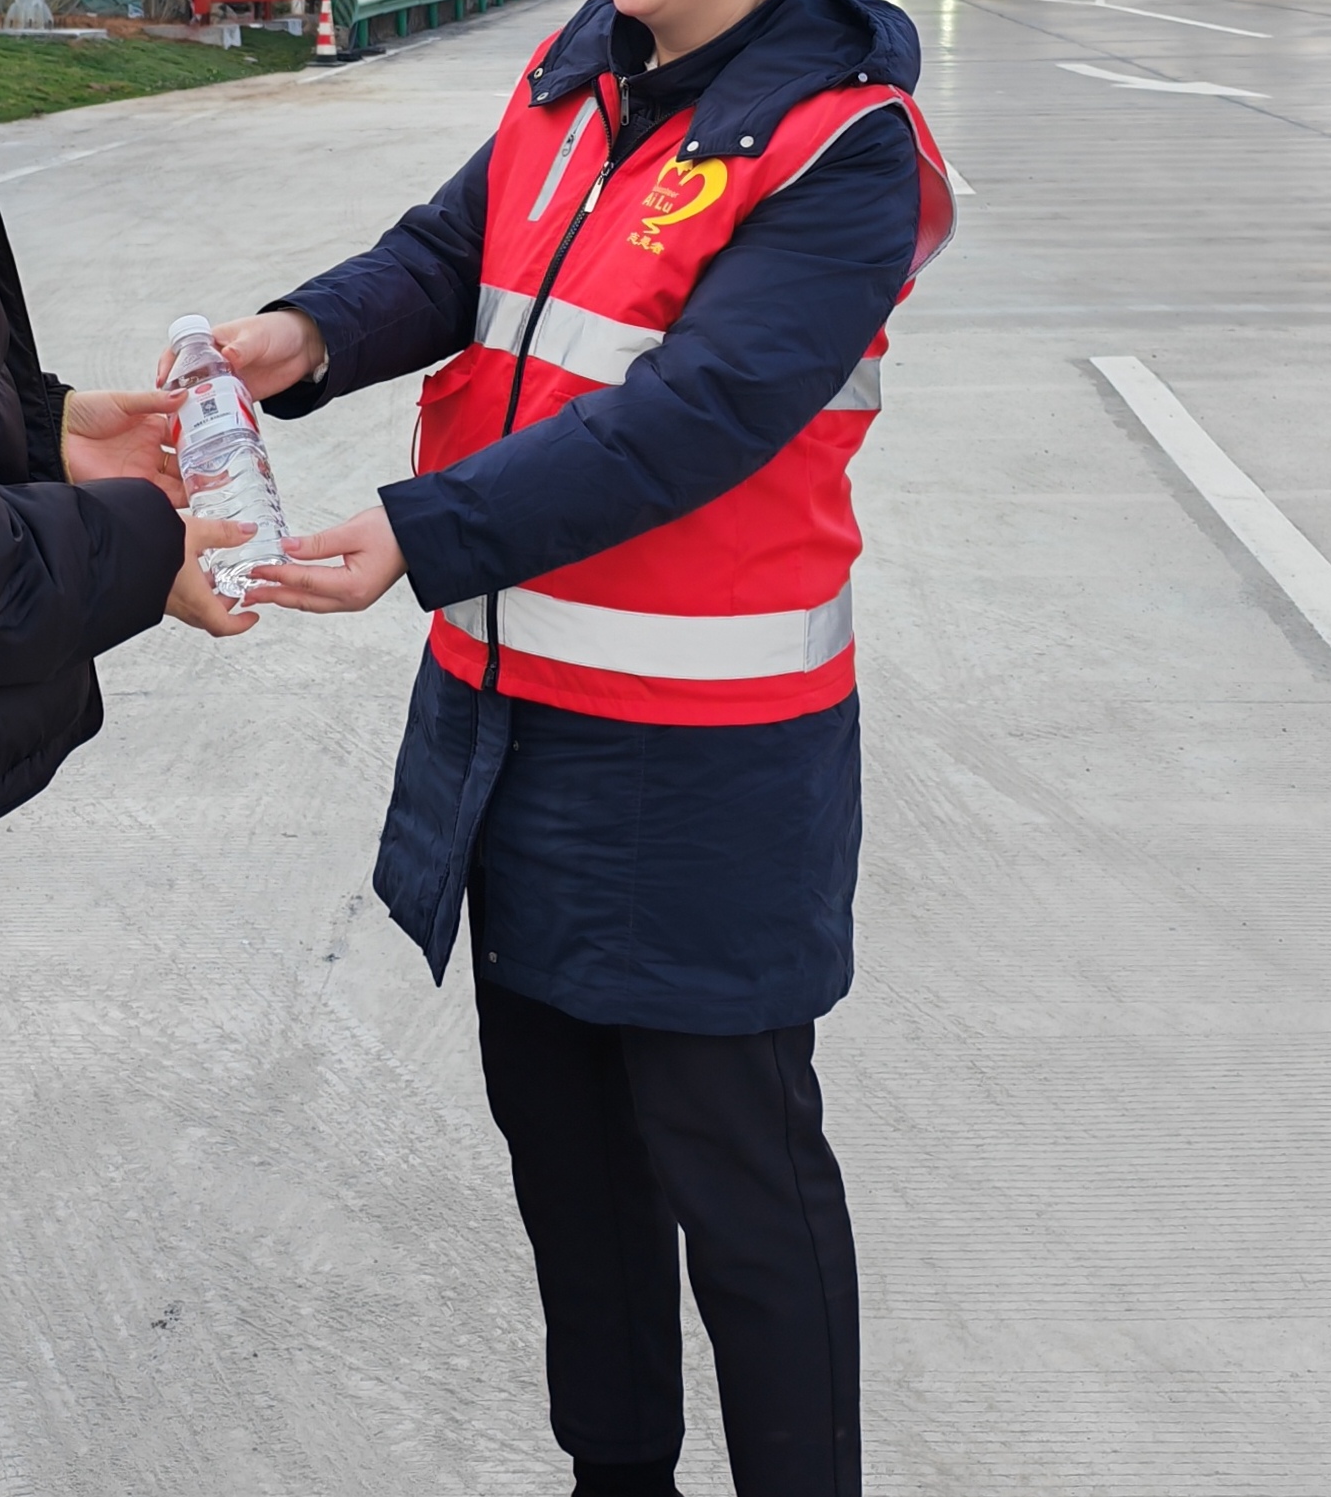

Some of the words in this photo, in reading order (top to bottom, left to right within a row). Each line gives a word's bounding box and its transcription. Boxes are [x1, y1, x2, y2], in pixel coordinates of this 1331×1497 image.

[654, 195, 674, 213] Lu
[626, 232, 665, 255] 志愿者
